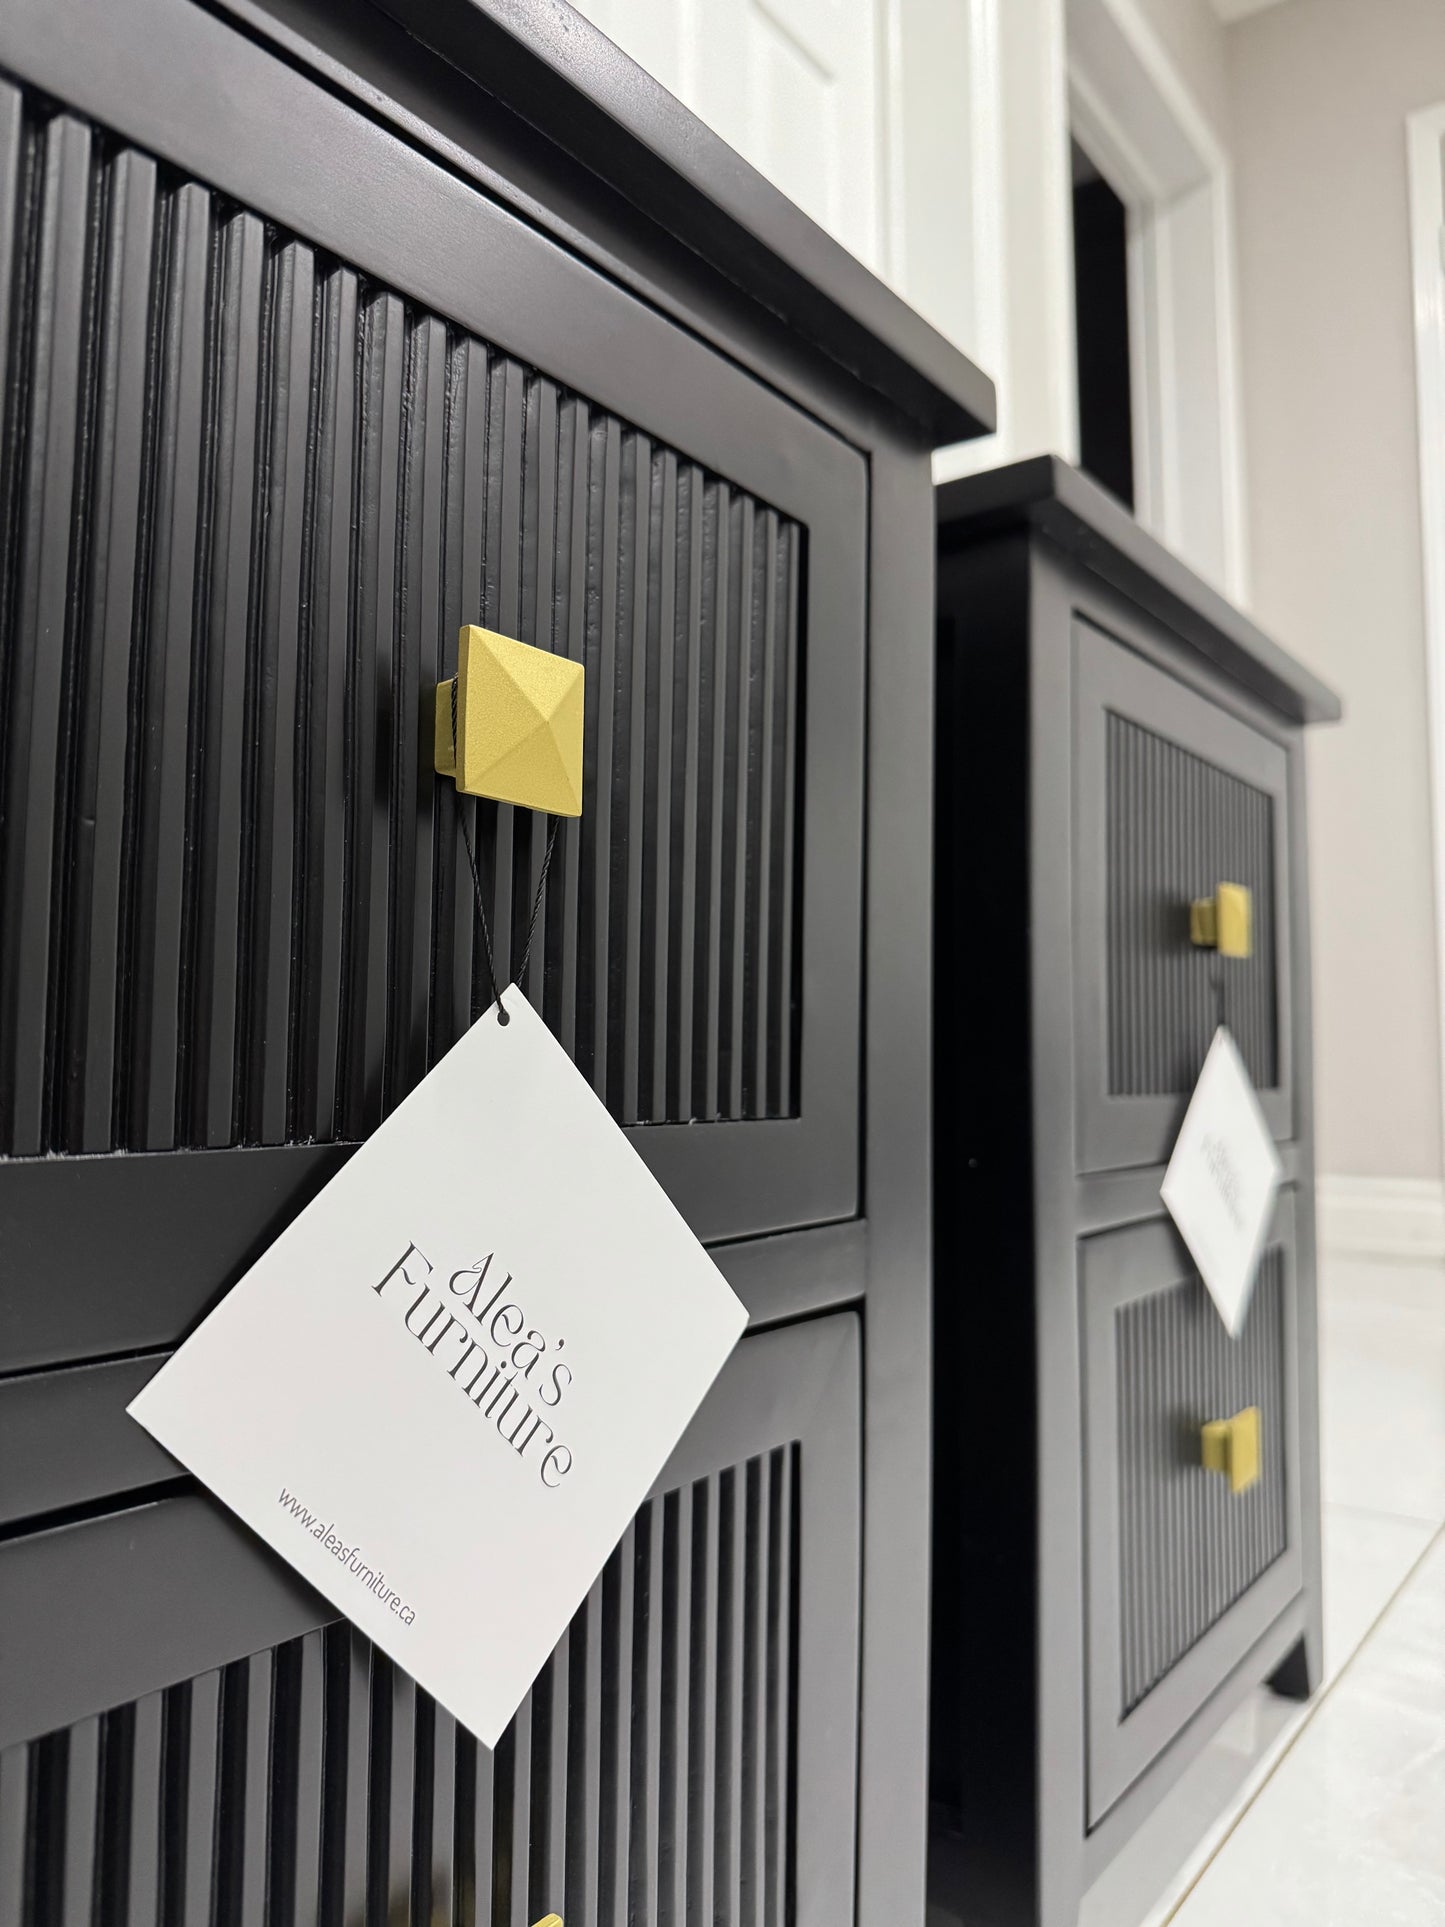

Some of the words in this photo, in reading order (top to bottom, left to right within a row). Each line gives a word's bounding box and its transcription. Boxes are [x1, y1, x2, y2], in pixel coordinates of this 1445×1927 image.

[371, 1240, 573, 1488] Furniture
[449, 1252, 573, 1407] Alea's
[278, 1488, 416, 1626] www.aleasfurniture.ca
